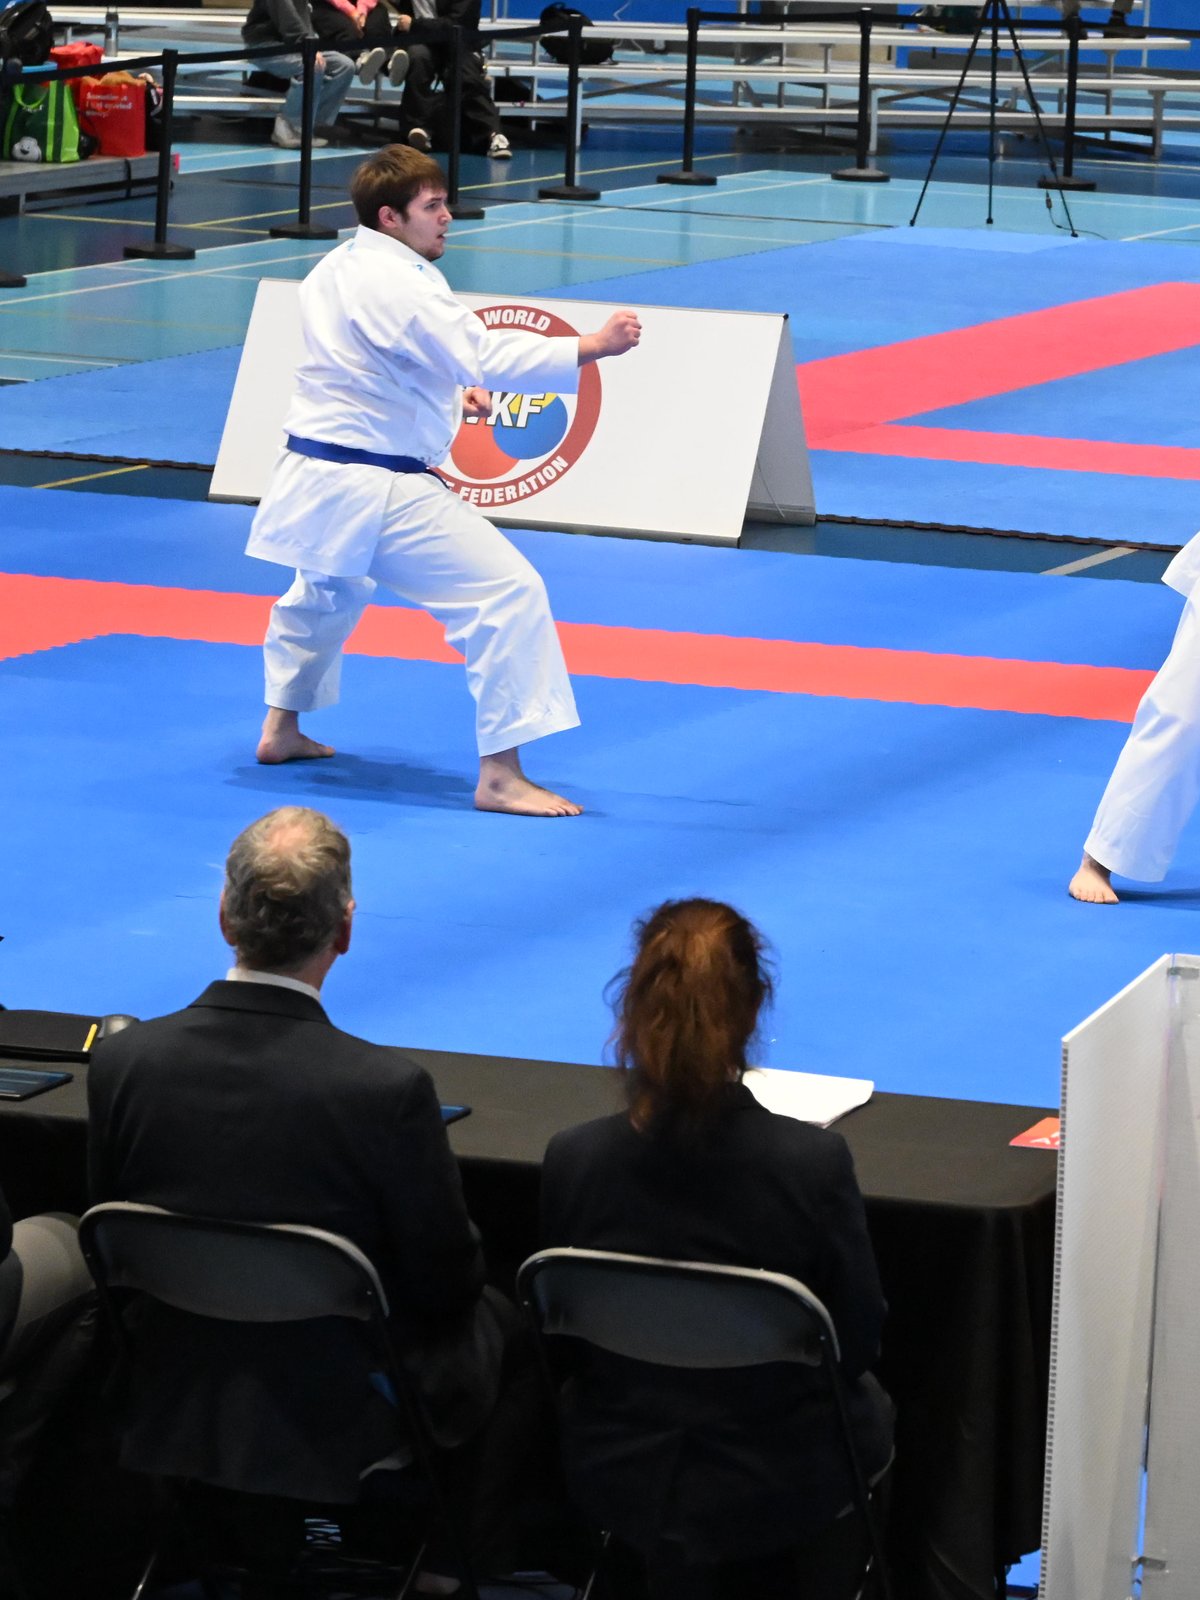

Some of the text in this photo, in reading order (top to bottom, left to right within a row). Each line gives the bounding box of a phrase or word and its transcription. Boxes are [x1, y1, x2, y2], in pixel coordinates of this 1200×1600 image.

[483, 309, 551, 332] WORLD
[465, 391, 546, 428] KF
[459, 455, 569, 504] FEDERATION
